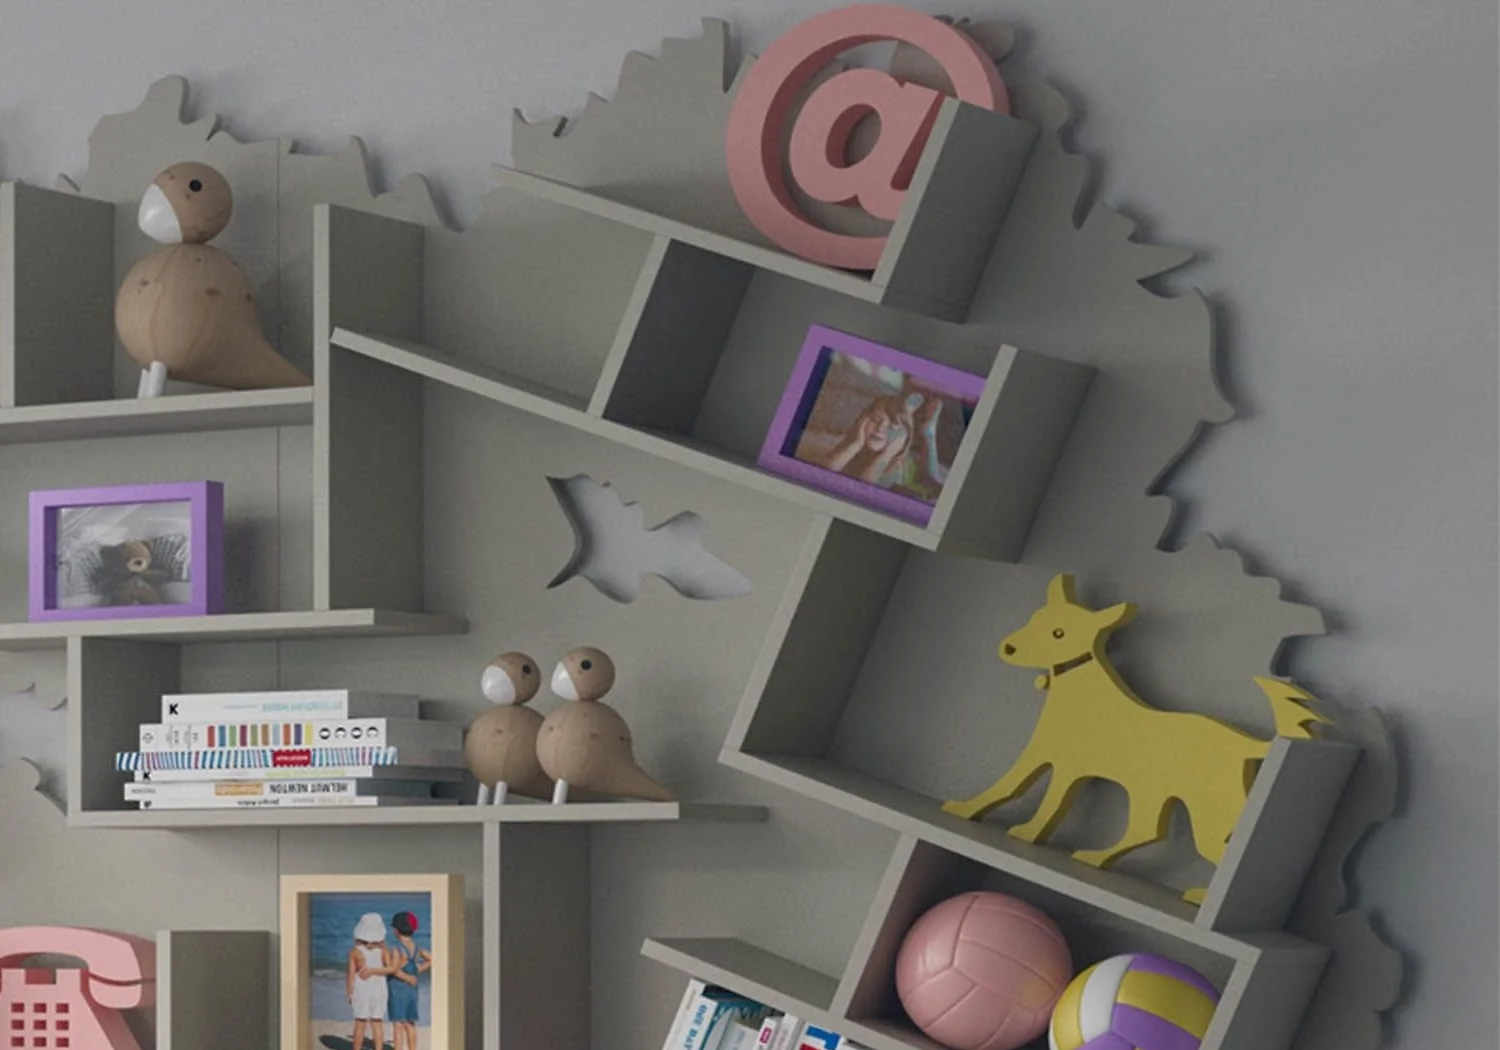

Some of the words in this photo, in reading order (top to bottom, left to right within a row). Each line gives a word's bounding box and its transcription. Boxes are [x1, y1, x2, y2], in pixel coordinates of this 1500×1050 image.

[726, 3, 1011, 270] @
[269, 783, 309, 795] NEWTON
[311, 783, 350, 795] HELMUT
